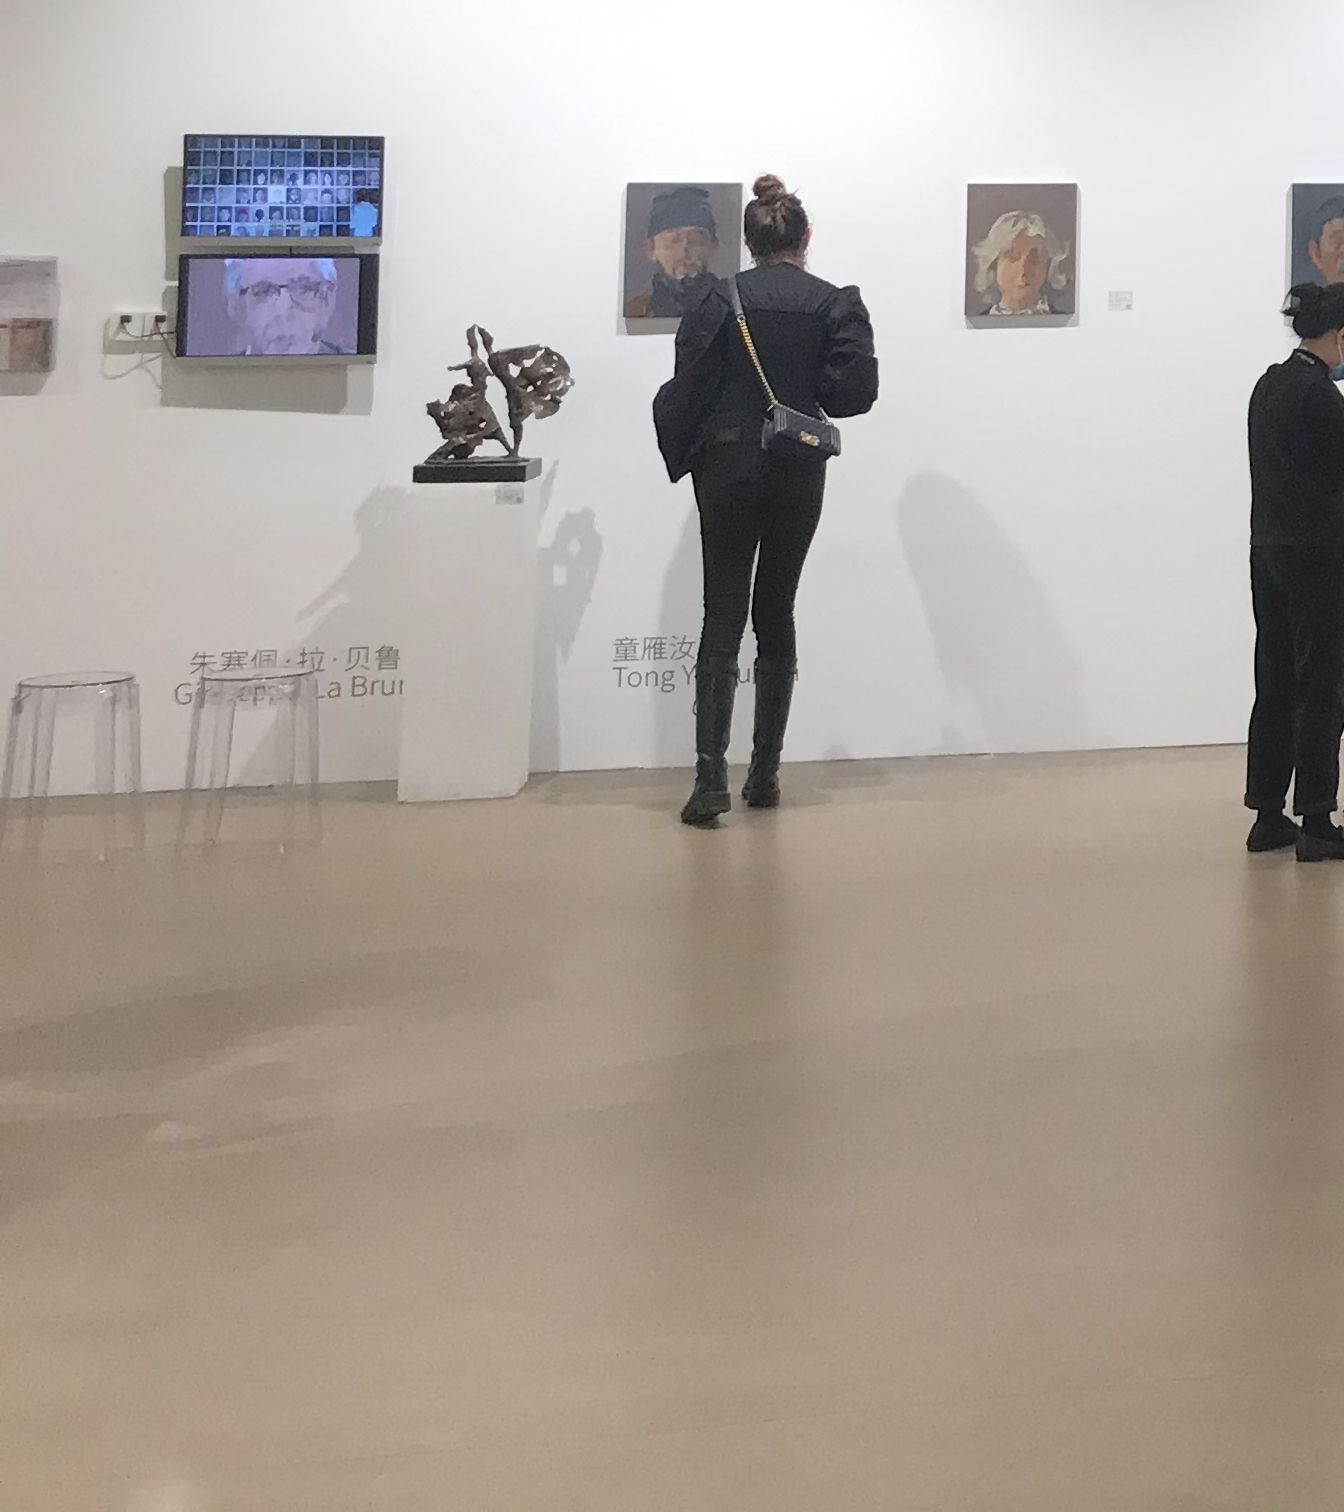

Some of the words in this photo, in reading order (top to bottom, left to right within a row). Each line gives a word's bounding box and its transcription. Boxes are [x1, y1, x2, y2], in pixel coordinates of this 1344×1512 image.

[612, 634, 697, 663] 童雁汝
[612, 666, 676, 693] Tong
